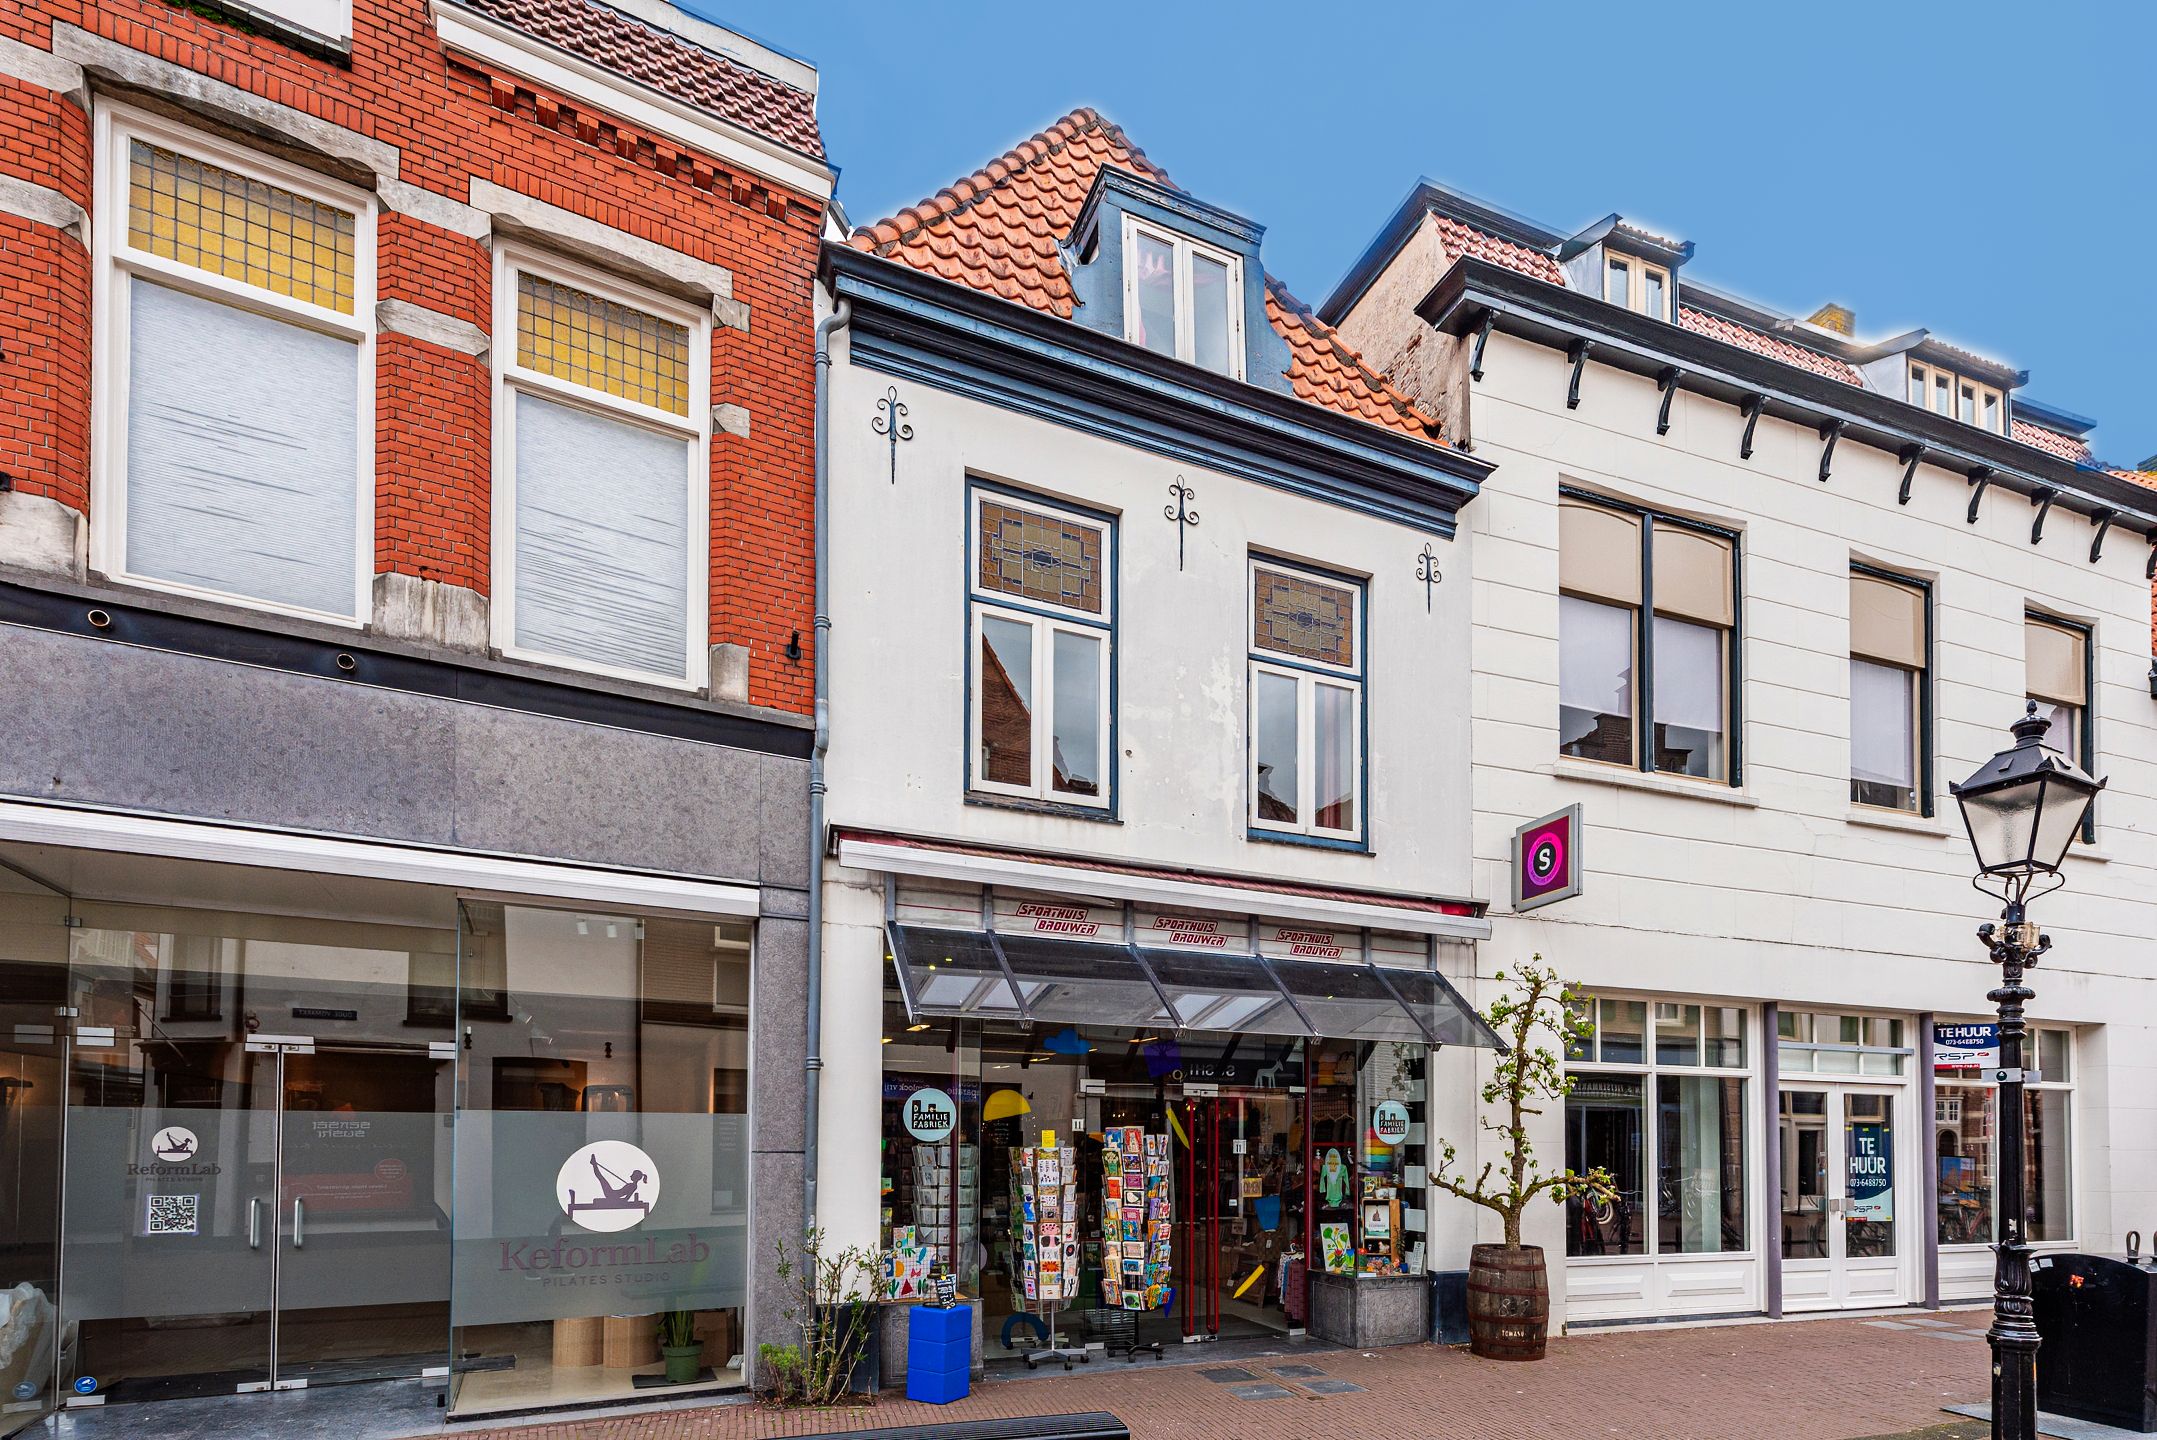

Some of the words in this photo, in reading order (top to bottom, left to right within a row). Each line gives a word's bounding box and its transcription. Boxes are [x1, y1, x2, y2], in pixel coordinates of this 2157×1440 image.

[1538, 848, 1551, 871] S
[1018, 904, 1085, 921] SPORTHUIS
[1037, 919, 1097, 934] BROUWER
[1155, 918, 1216, 933] SPORTHUIS
[1171, 932, 1226, 946] BROUWER
[1277, 930, 1333, 945] SPORTHUIS
[1292, 943, 1341, 957] BROUWER
[1937, 1027, 1954, 1038] TE
[1955, 1026, 1992, 1038] HUUR
[1934, 1052, 1975, 1061] RSP
[913, 1113, 949, 1121] FAMILIE
[913, 1121, 949, 1129] FABRIEK
[1858, 1137, 1875, 1155] TE
[127, 1163, 222, 1176] ReformLab
[1849, 1156, 1886, 1174] HUUR
[1849, 1178, 1887, 1187] 073-6488750
[543, 1274, 608, 1288] PILATES
[614, 1273, 670, 1285] STUDIO
